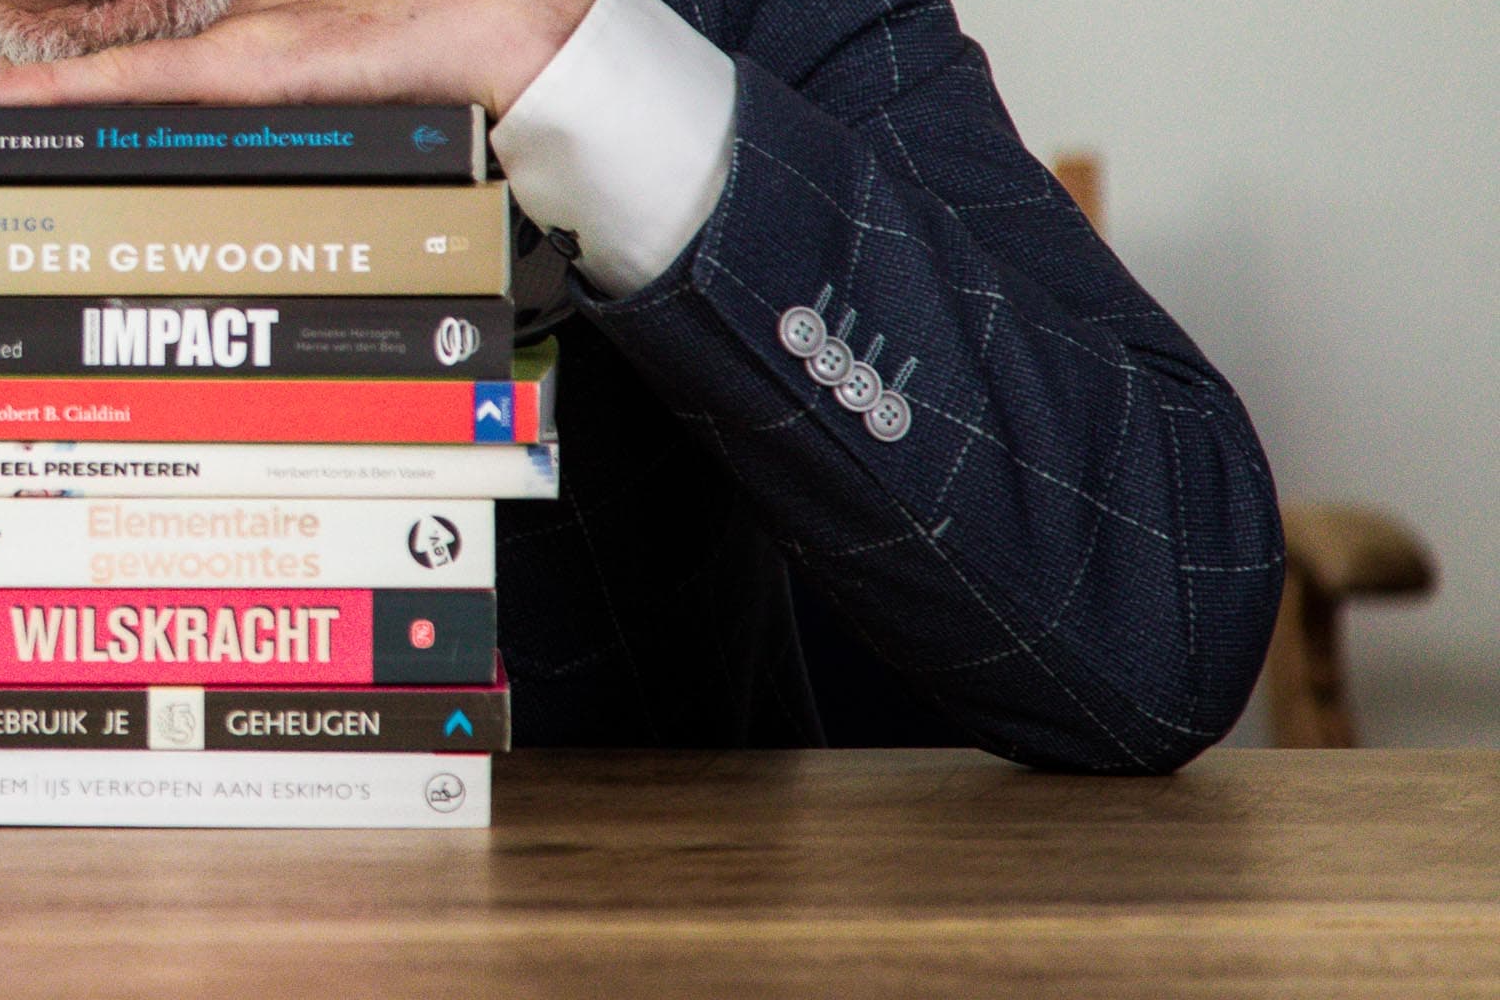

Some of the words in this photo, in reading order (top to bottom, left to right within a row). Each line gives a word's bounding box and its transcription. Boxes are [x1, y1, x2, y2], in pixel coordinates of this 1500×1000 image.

[96, 128, 141, 149] Het
[146, 127, 228, 148] slimme
[232, 126, 354, 148] onbewuste
[8, 243, 92, 272] DER
[108, 243, 372, 273] GEWOONTE
[82, 307, 280, 368] IMPACT
[44, 405, 61, 421] B.
[64, 404, 132, 422] Cialdini
[44, 461, 200, 478] PRESENTEREN
[87, 506, 321, 539] Elementaire
[90, 547, 321, 583] gewoontes
[9, 604, 341, 663] WILSKRACHT
[102, 709, 129, 735] JE
[225, 710, 381, 737] GEHEUGEN
[44, 778, 71, 799] IJS
[78, 780, 202, 798] VERKOPEN
[213, 781, 263, 799] AAN
[272, 782, 372, 801] ESKIMO'S
